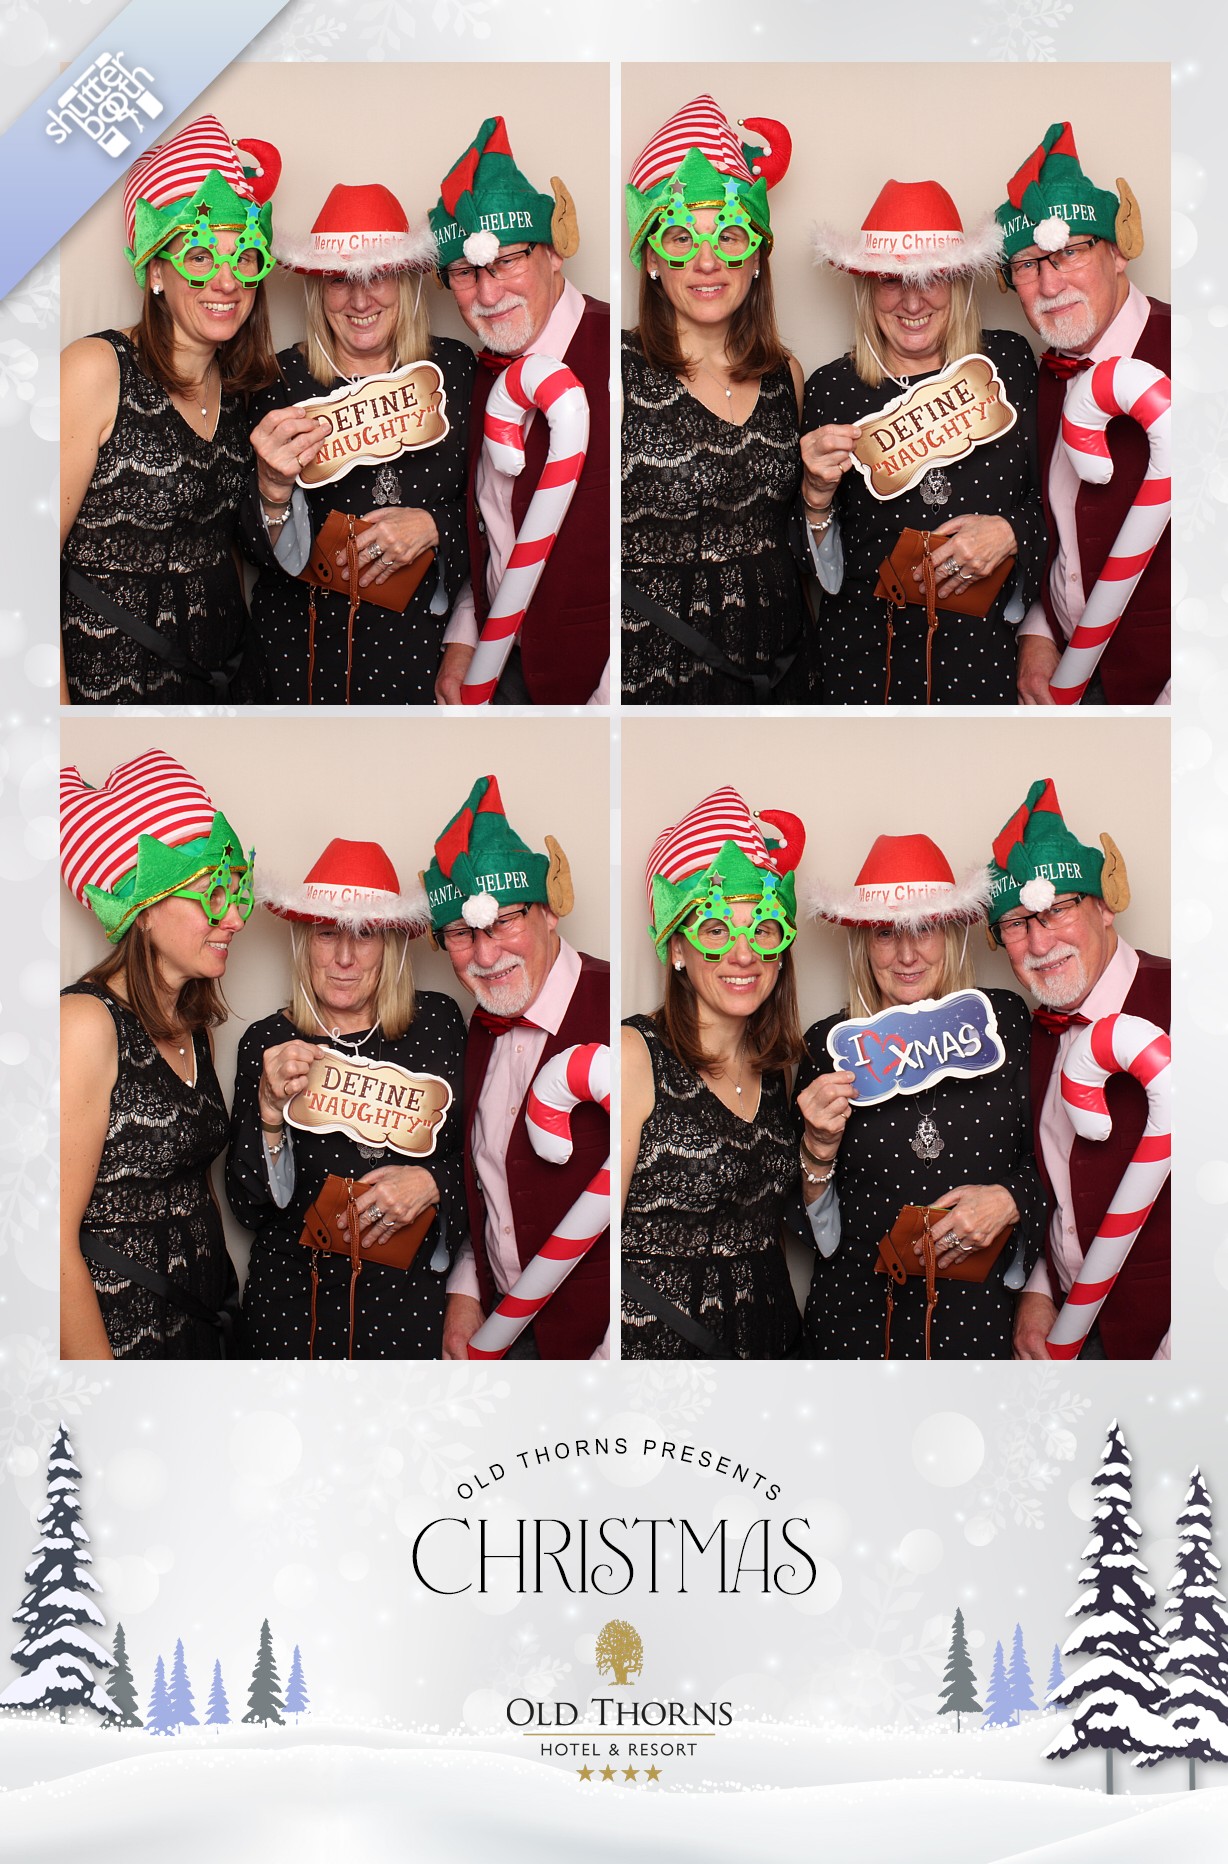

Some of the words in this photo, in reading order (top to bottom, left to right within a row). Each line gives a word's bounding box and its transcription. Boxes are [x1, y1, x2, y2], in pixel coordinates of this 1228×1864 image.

[479, 211, 533, 231] HELPER
[1003, 213, 1036, 238] ANTA
[314, 235, 344, 253] Merry
[865, 233, 897, 253] Merry
[870, 379, 975, 453] DEFINE
[871, 395, 996, 476] "NAUGHTY"
[429, 883, 466, 908] SANTA
[860, 888, 889, 904] Merry
[848, 1033, 871, 1066] I
[888, 1024, 982, 1076] XMAS
[321, 1065, 425, 1112] DEFINE
[303, 1090, 432, 1134] "NAUGHTY"
